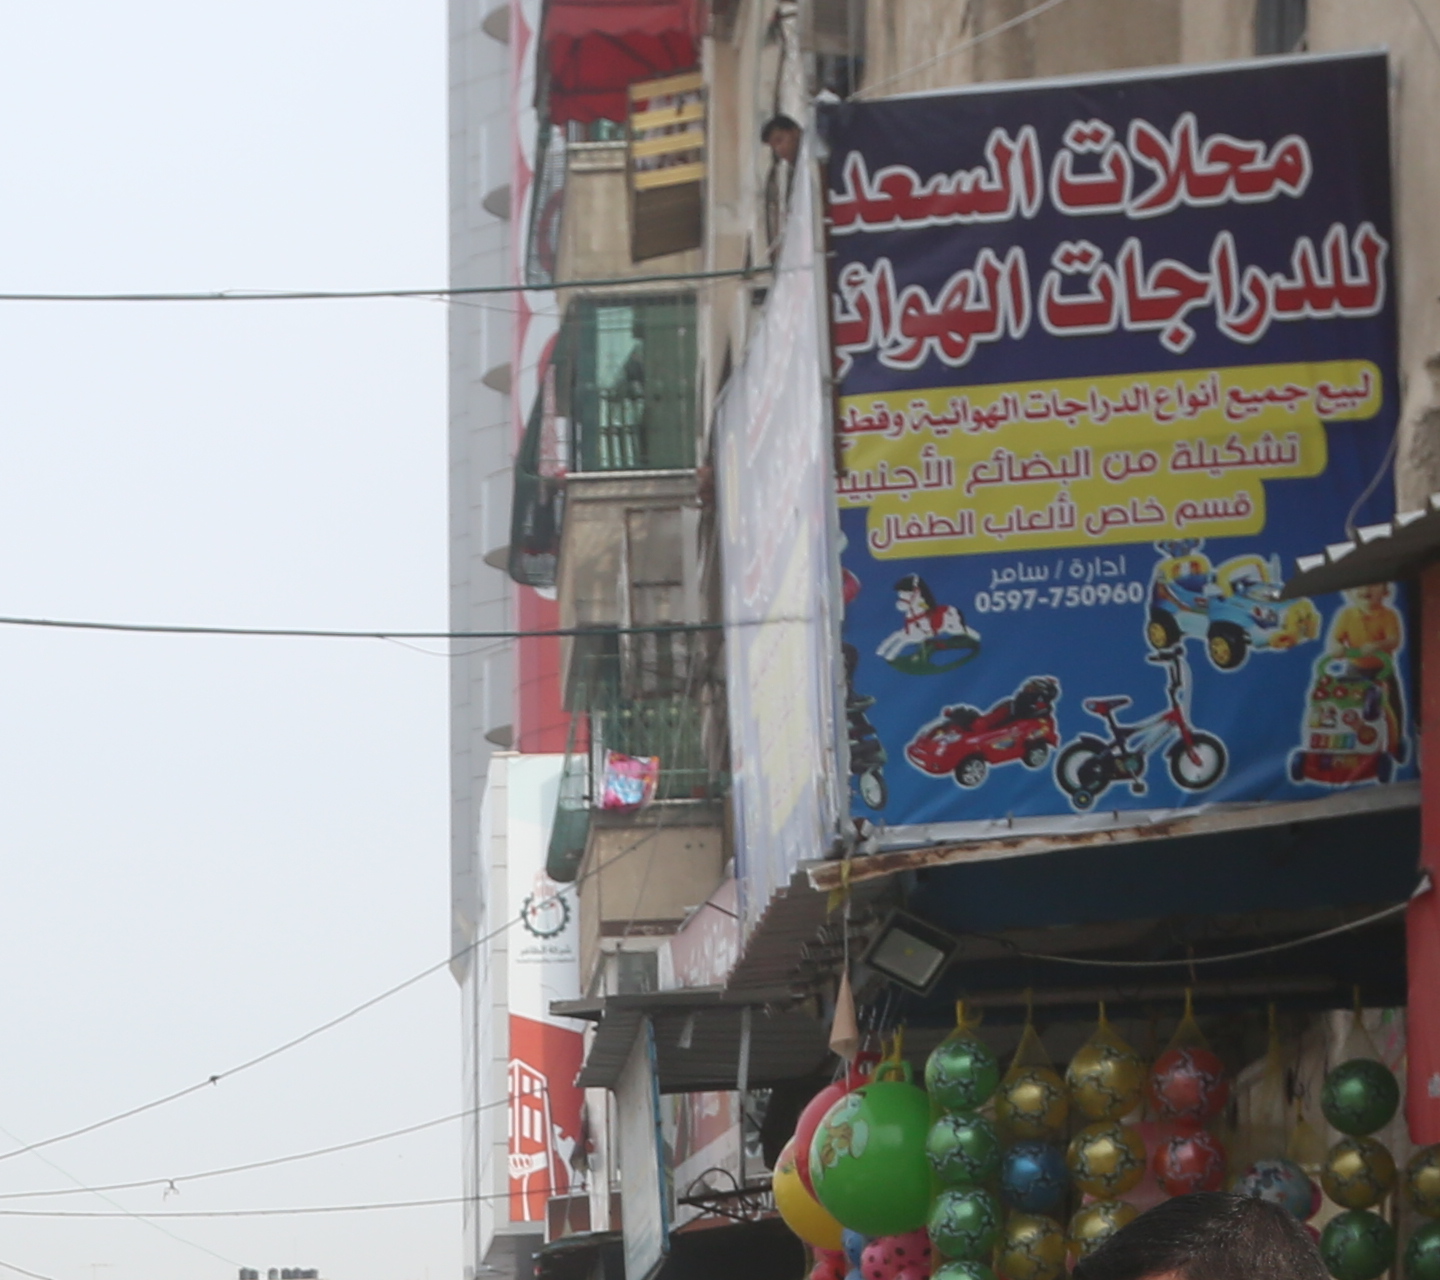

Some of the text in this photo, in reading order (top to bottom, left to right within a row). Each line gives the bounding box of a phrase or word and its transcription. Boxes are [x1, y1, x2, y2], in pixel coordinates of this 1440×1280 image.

[1051, 112, 1312, 217] محلات
[1042, 223, 1388, 353] للدراجات
[911, 392, 1019, 434] الهوائية
[1023, 385, 1150, 425] الدراجات
[1154, 377, 1219, 421] أنواع
[1226, 380, 1308, 420] جميع
[1315, 372, 1370, 416] لبيع
[965, 447, 1090, 494] البضائع
[1104, 449, 1158, 482] من
[1171, 432, 1299, 473] تشكيلة
[871, 493, 1252, 551] قسم خاص لألعاب الطفال
[990, 563, 1050, 588] سامر
[975, 582, 1144, 613] 0597-750960
